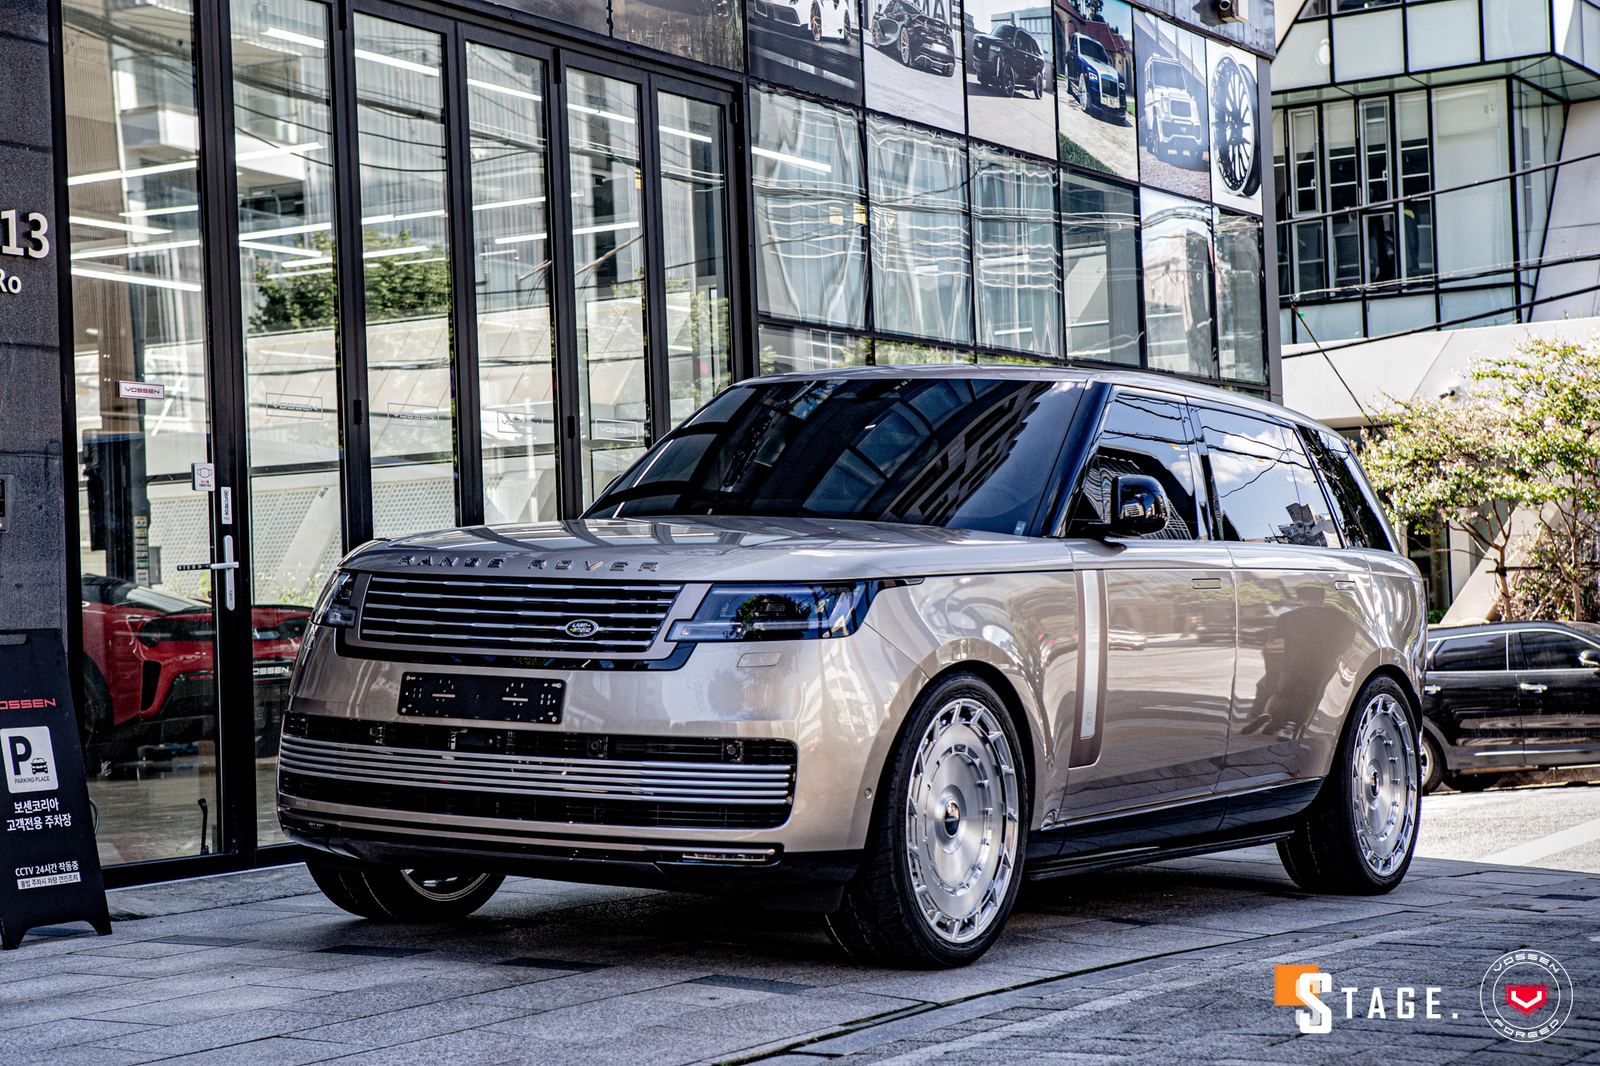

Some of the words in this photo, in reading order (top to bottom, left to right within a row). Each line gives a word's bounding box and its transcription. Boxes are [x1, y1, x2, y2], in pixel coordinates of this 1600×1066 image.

[1, 209, 49, 259] 13
[124, 387, 161, 395] VOSSEN
[398, 554, 507, 569] RANGE
[527, 558, 661, 573] ROVER
[253, 666, 290, 675] OSSEN
[0, 698, 56, 710] OSSEN
[8, 735, 33, 776] P
[14, 797, 59, 814] 보센코리아
[6, 815, 43, 832] 고객전용
[44, 812, 72, 829] 주차장
[15, 867, 34, 876] CCTV
[35, 863, 57, 874] 24시간
[58, 861, 79, 872] 작동중
